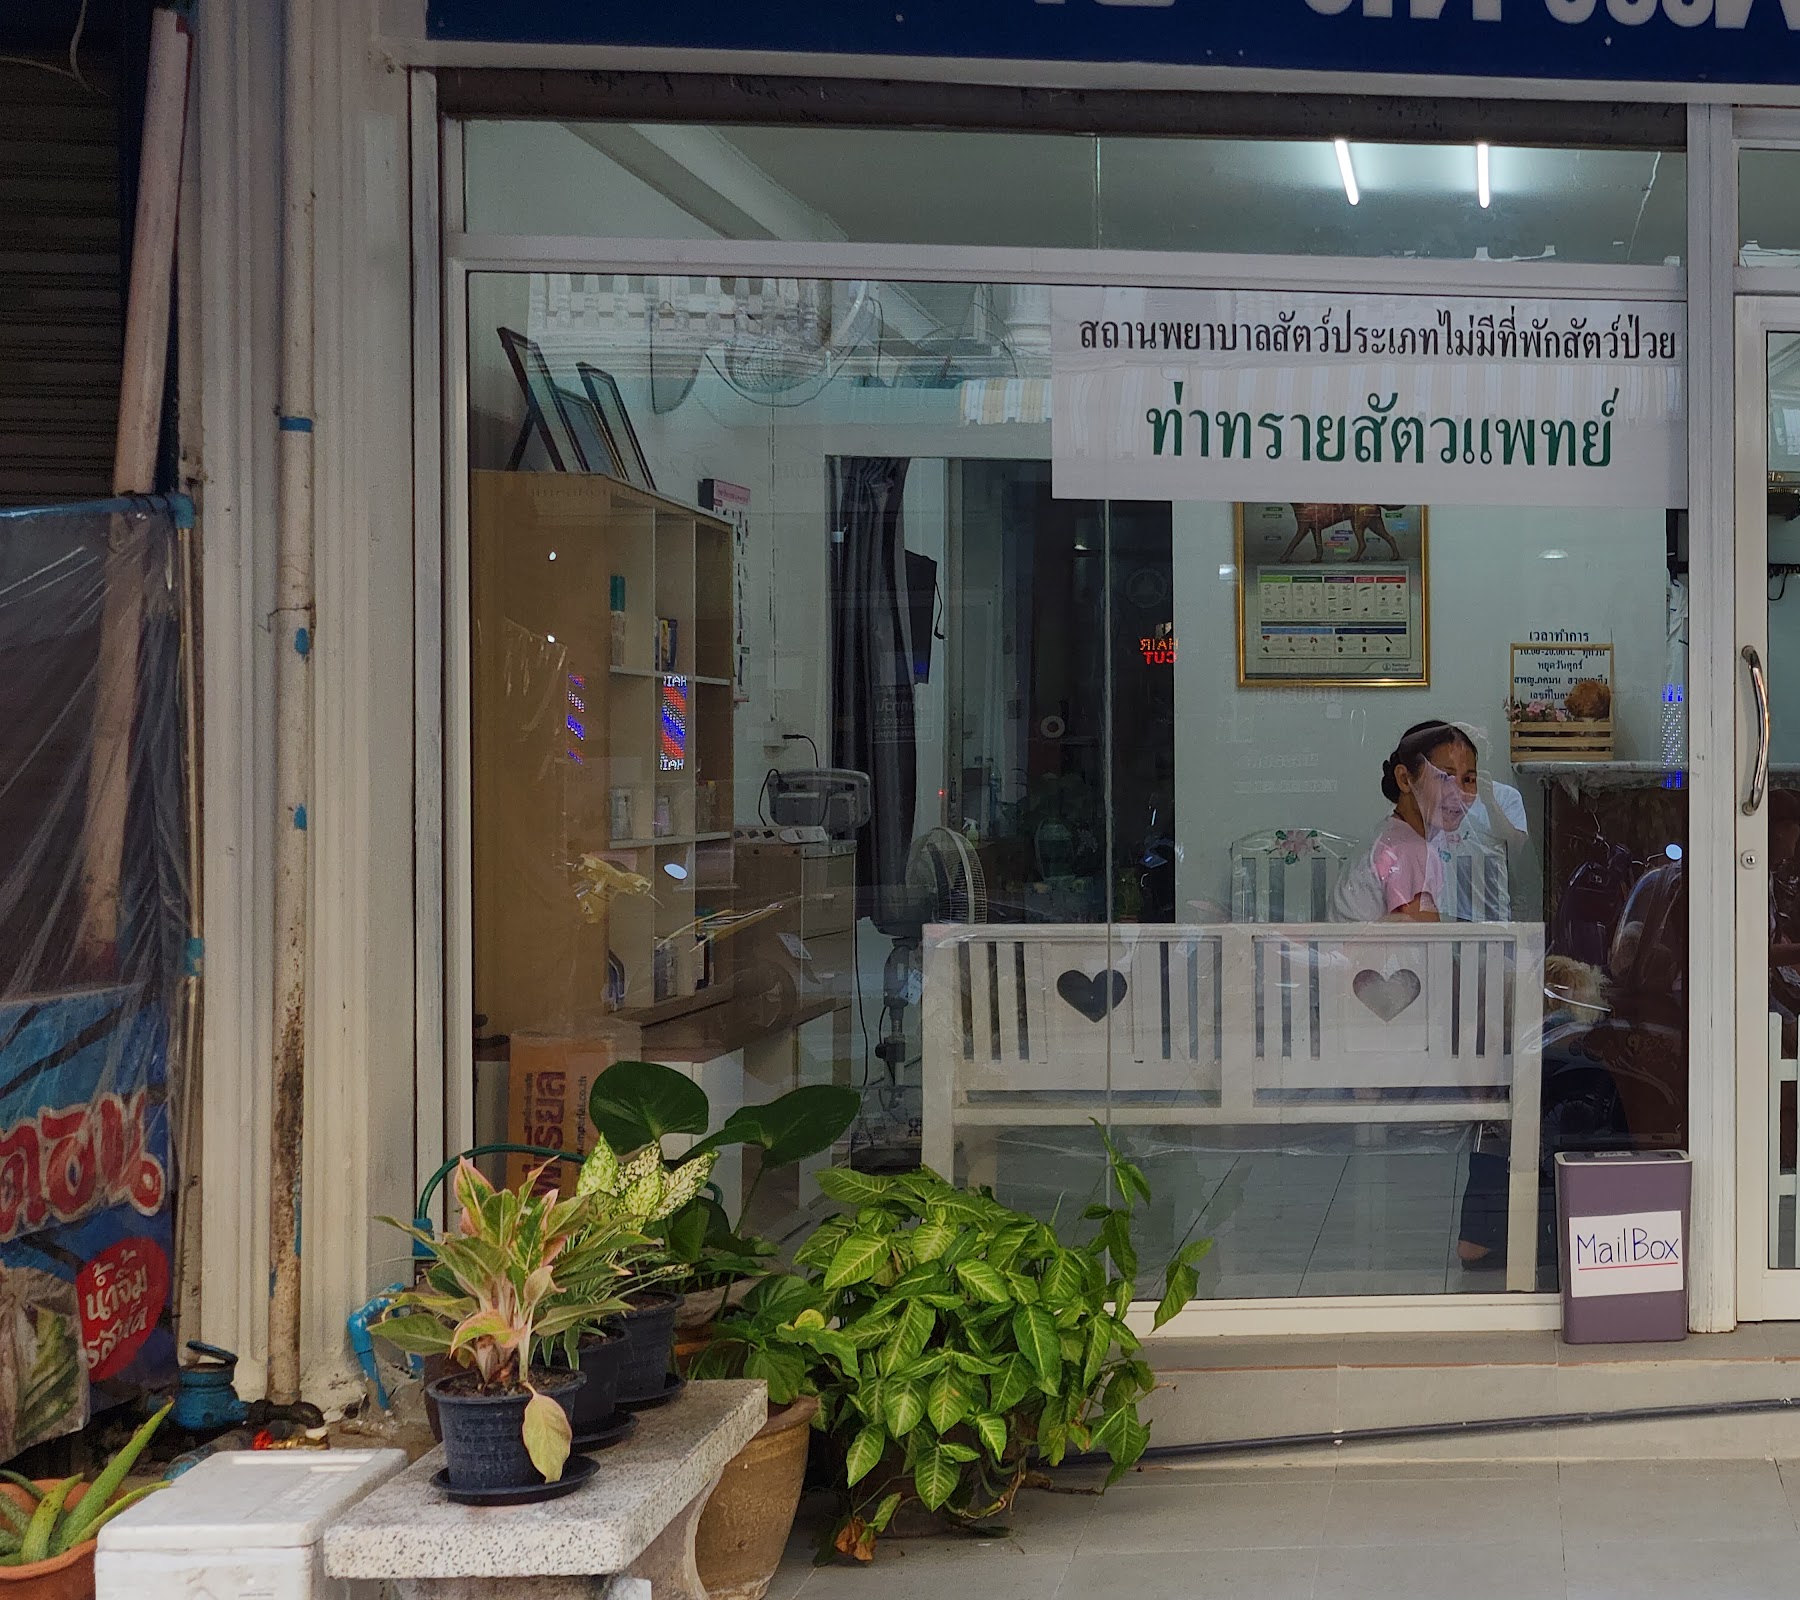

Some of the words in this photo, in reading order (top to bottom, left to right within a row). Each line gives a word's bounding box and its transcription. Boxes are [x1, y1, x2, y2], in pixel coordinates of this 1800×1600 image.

[1078, 306, 1678, 361] สถานพยาบาลสัตว์ประเภทไม่มีที่พักสัตว์ป่วย
[1145, 382, 1620, 468] ท่าทรายสัตวแพทย์
[1529, 629, 1589, 642] เวลาทำการ
